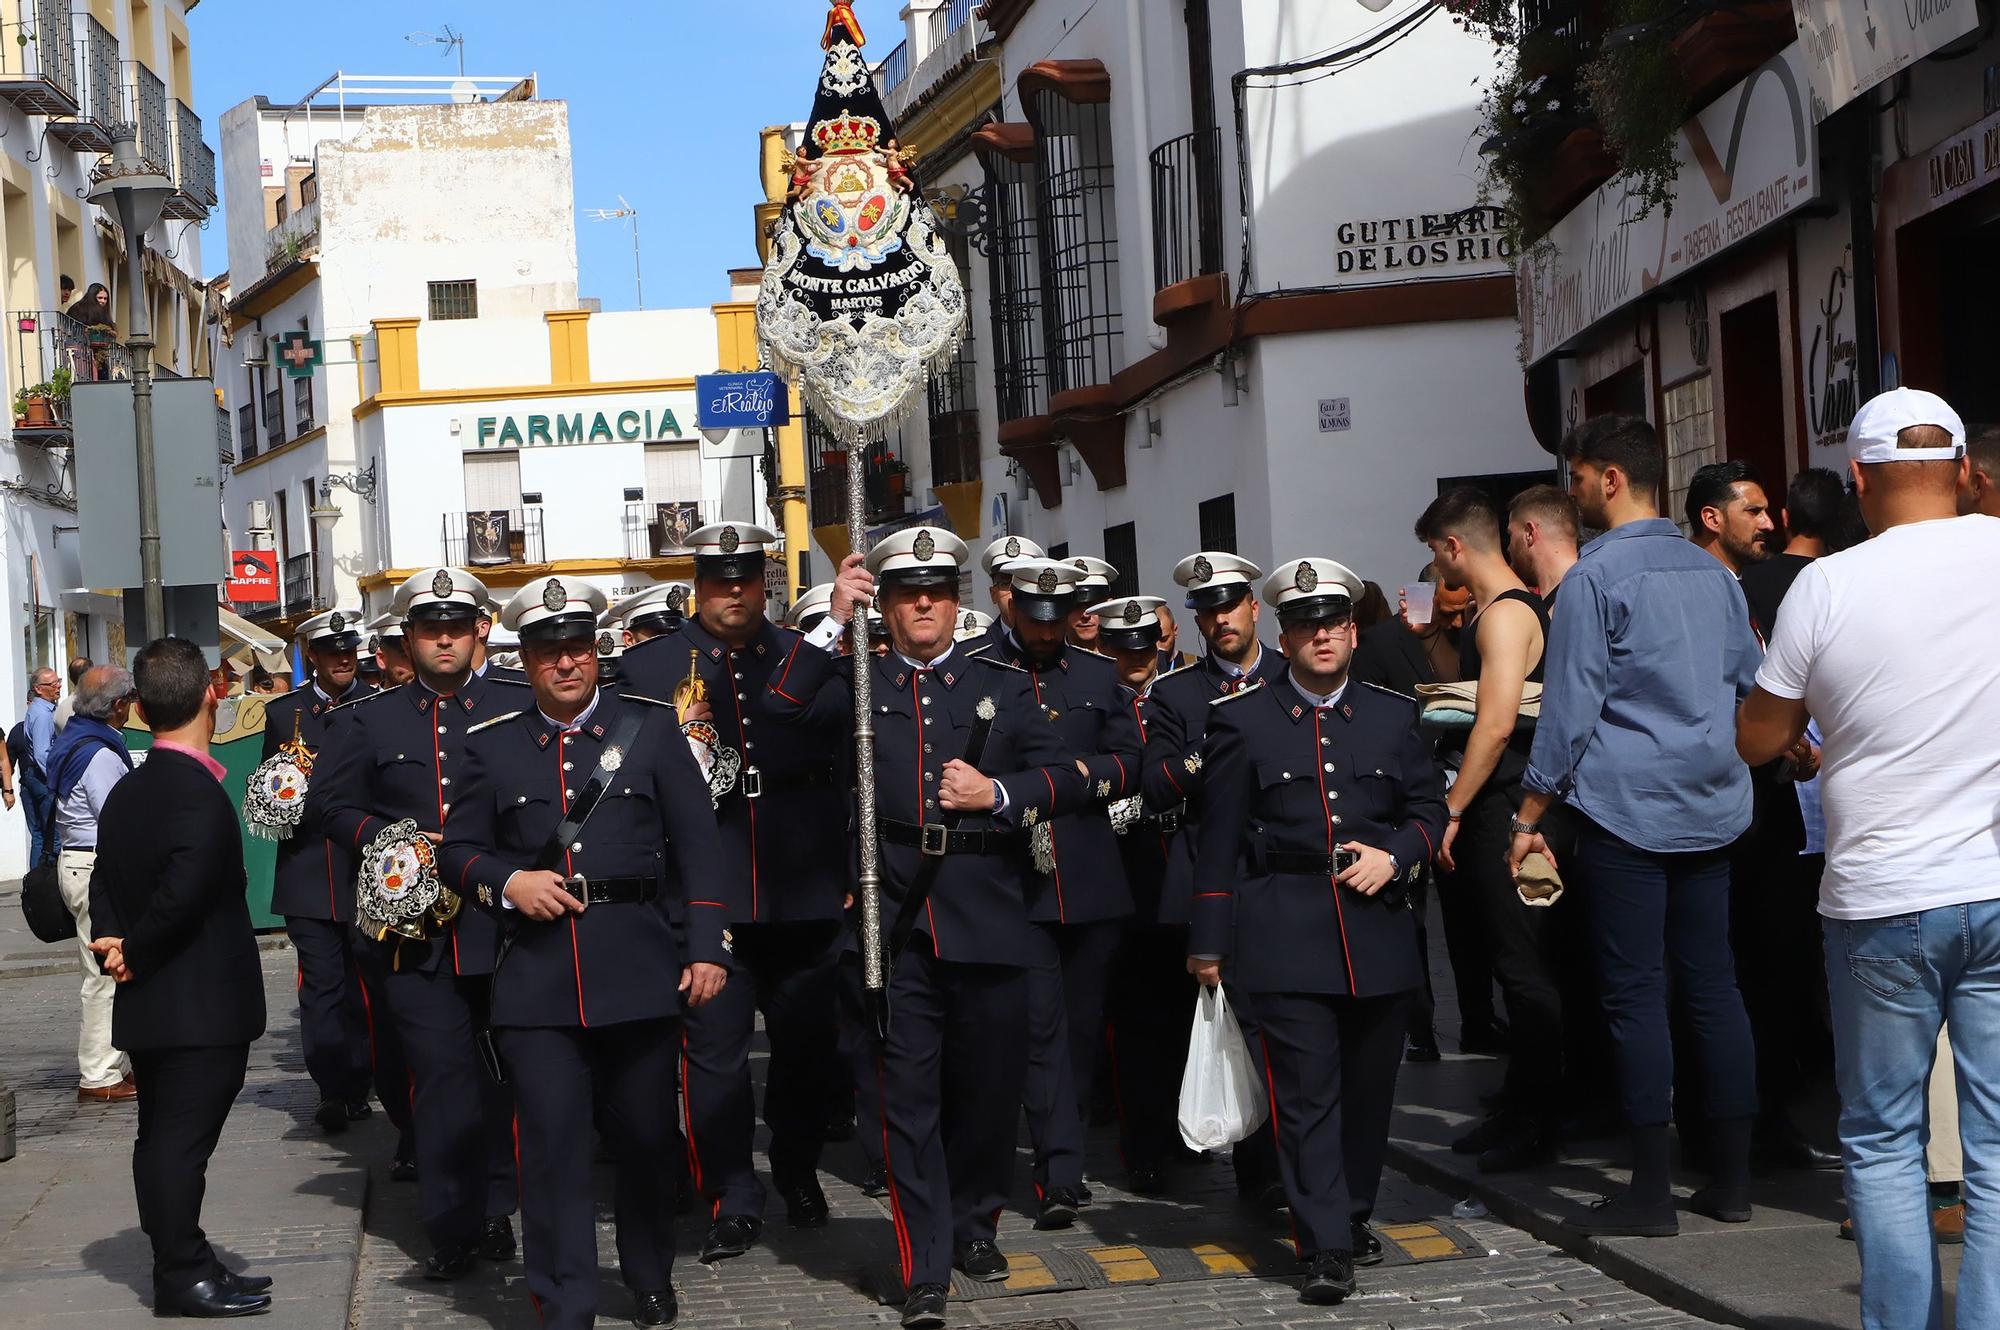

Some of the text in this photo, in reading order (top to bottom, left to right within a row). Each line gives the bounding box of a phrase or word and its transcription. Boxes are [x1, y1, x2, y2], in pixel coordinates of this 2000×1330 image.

[1943, 138, 1977, 191] CASA
[1984, 121, 2000, 173] DE
[1337, 210, 1511, 245] GUTIERRE
[1683, 174, 1790, 265] TABERNA RESTAURANTE
[787, 260, 925, 294] MONTE CALVARIO
[830, 296, 884, 310] MARTOS
[477, 408, 683, 447] FARMACIA
[230, 577, 272, 585] MAPFRE
